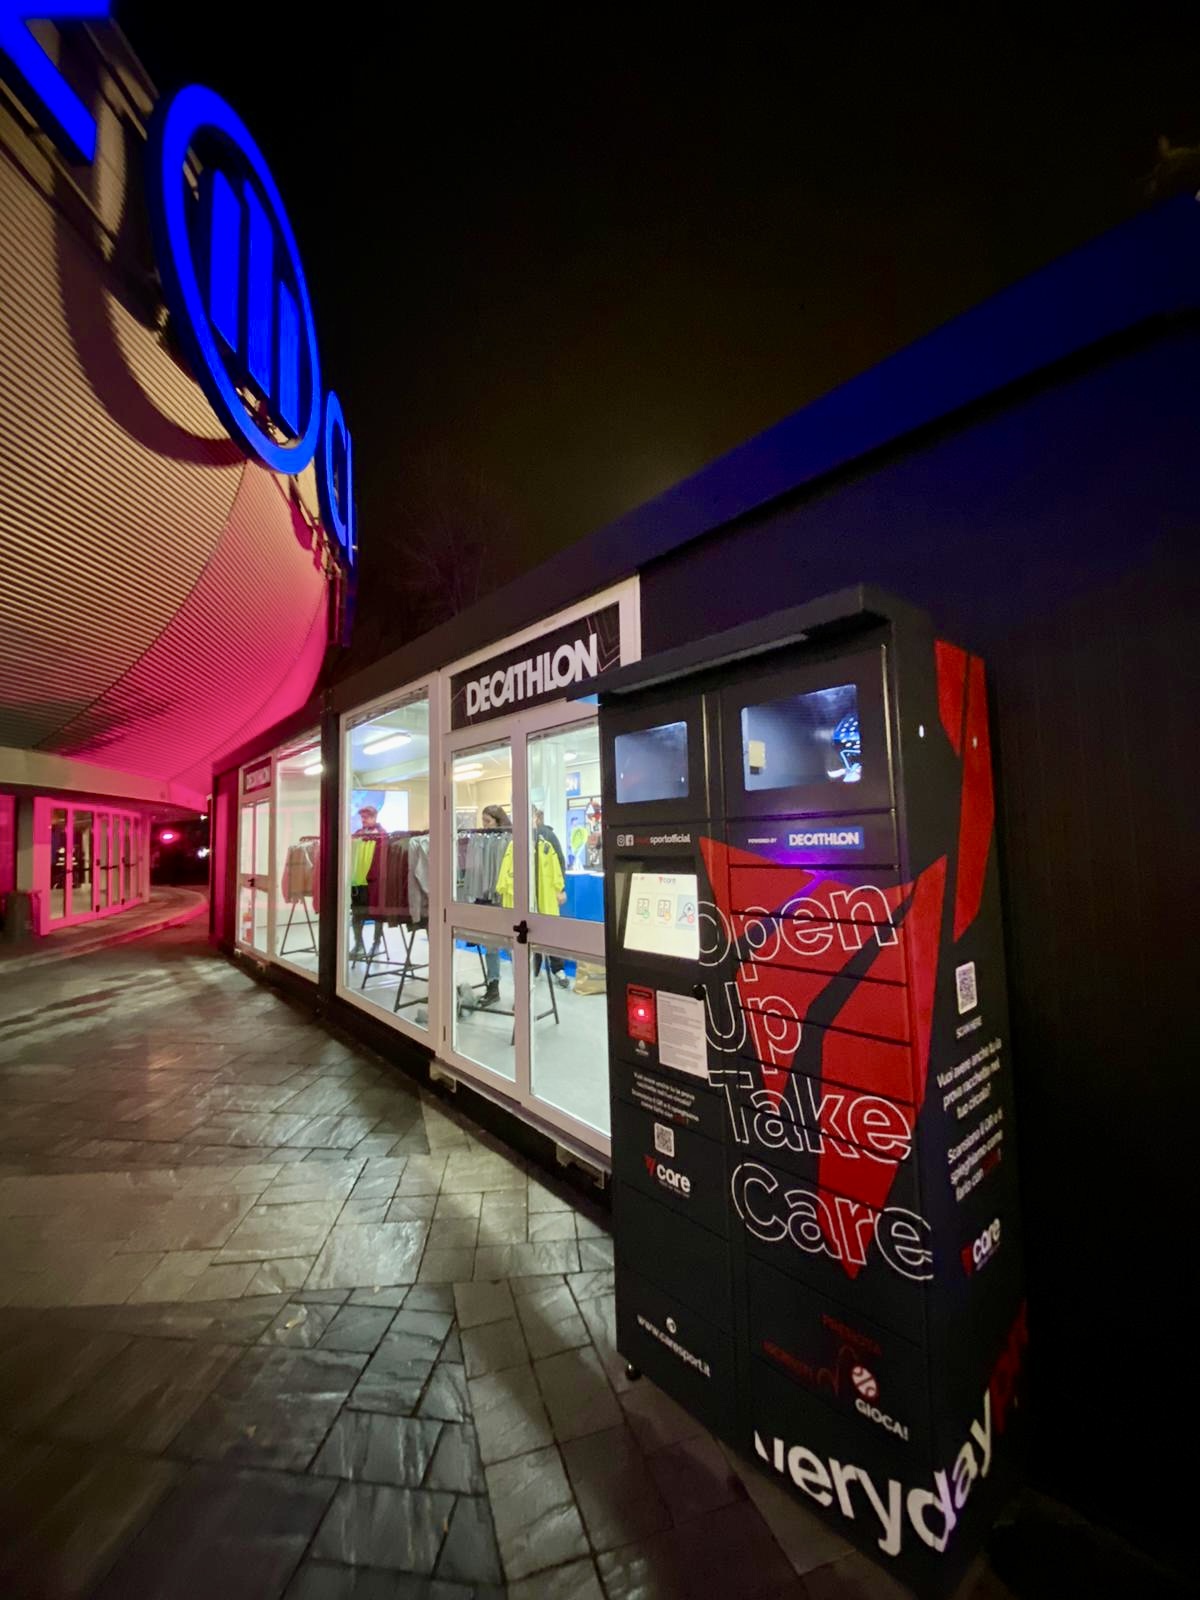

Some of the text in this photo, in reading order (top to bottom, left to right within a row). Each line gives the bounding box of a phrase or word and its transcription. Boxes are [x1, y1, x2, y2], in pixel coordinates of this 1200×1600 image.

[466, 633, 598, 717] DECATHLON
[789, 832, 859, 846] DECATHLON
[699, 885, 899, 982] Open
[694, 981, 802, 1075] Up
[708, 1071, 912, 1163] Take
[656, 1163, 691, 1193] care
[731, 1162, 934, 1281] Care
[973, 1218, 1001, 1264] care
[855, 1398, 909, 1441] GIOCA!
